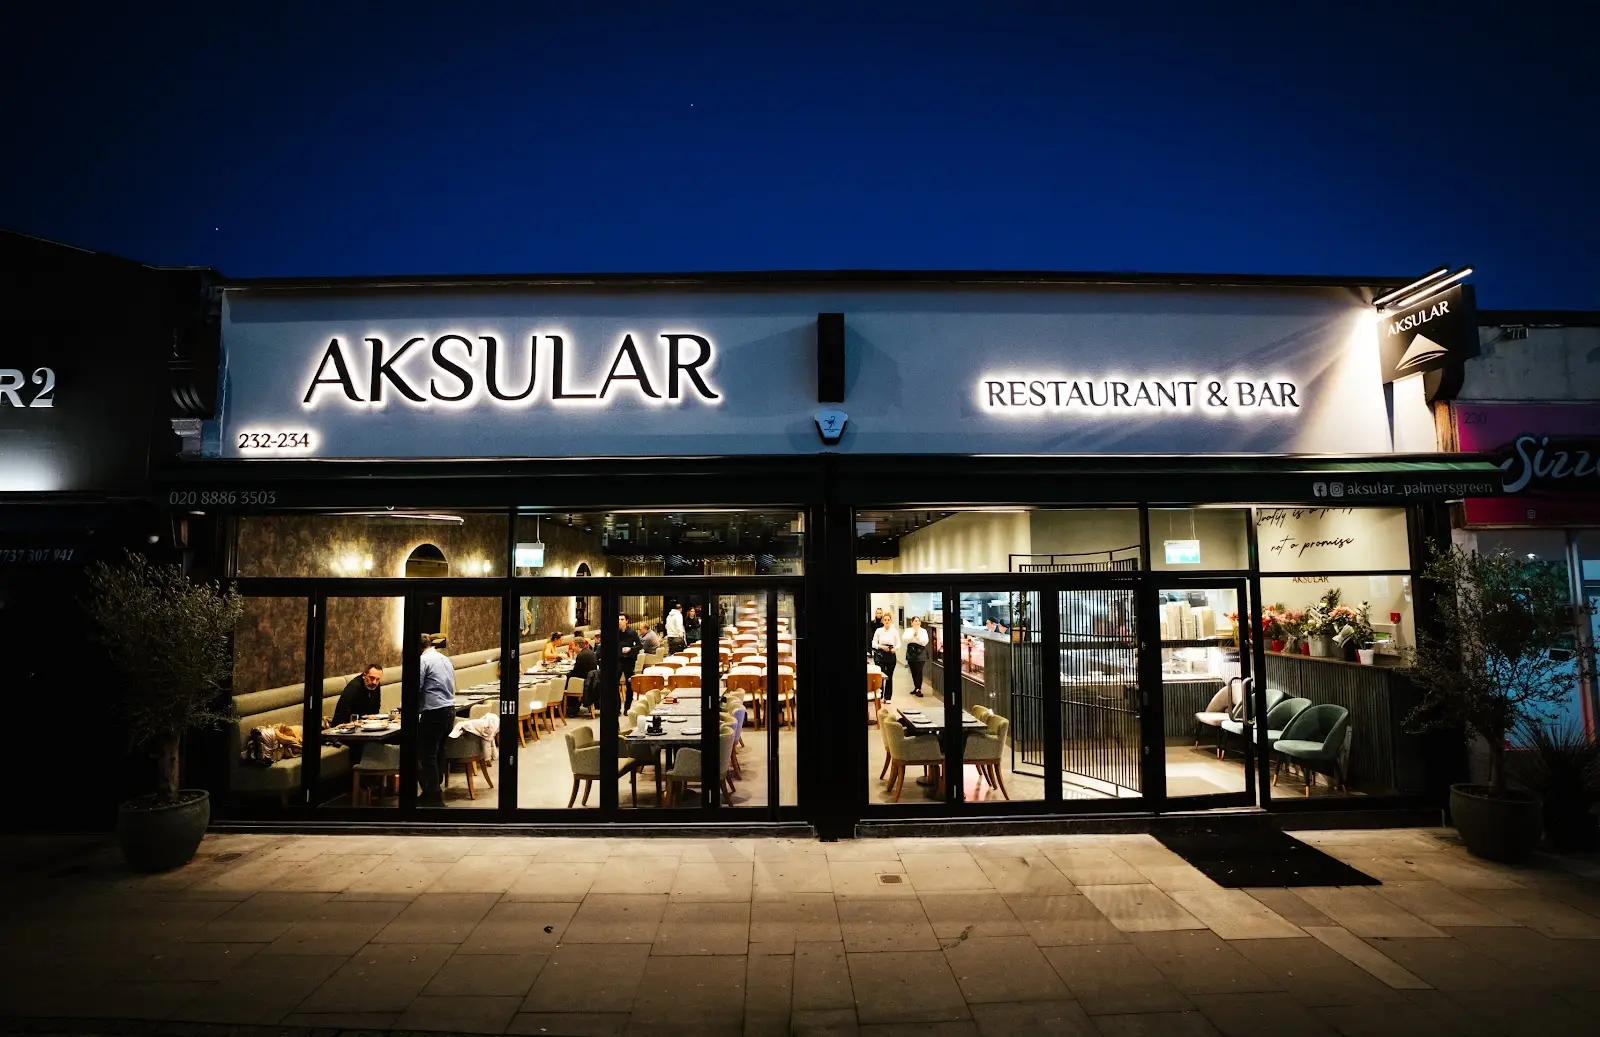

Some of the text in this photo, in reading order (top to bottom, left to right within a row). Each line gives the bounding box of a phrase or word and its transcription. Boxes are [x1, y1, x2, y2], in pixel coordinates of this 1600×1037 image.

[1386, 300, 1451, 337] AKSULAR
[303, 334, 719, 403] AKSULAR
[984, 380, 1300, 408] RESTAURANT & BAR
[238, 432, 310, 449] 232-234
[1499, 435, 1600, 493] Sizz
[169, 490, 277, 505] 020 8886 3503
[1347, 480, 1493, 497] aksular_palmersgreen
[1271, 535, 1296, 556] not
[1298, 537, 1355, 558] promise
